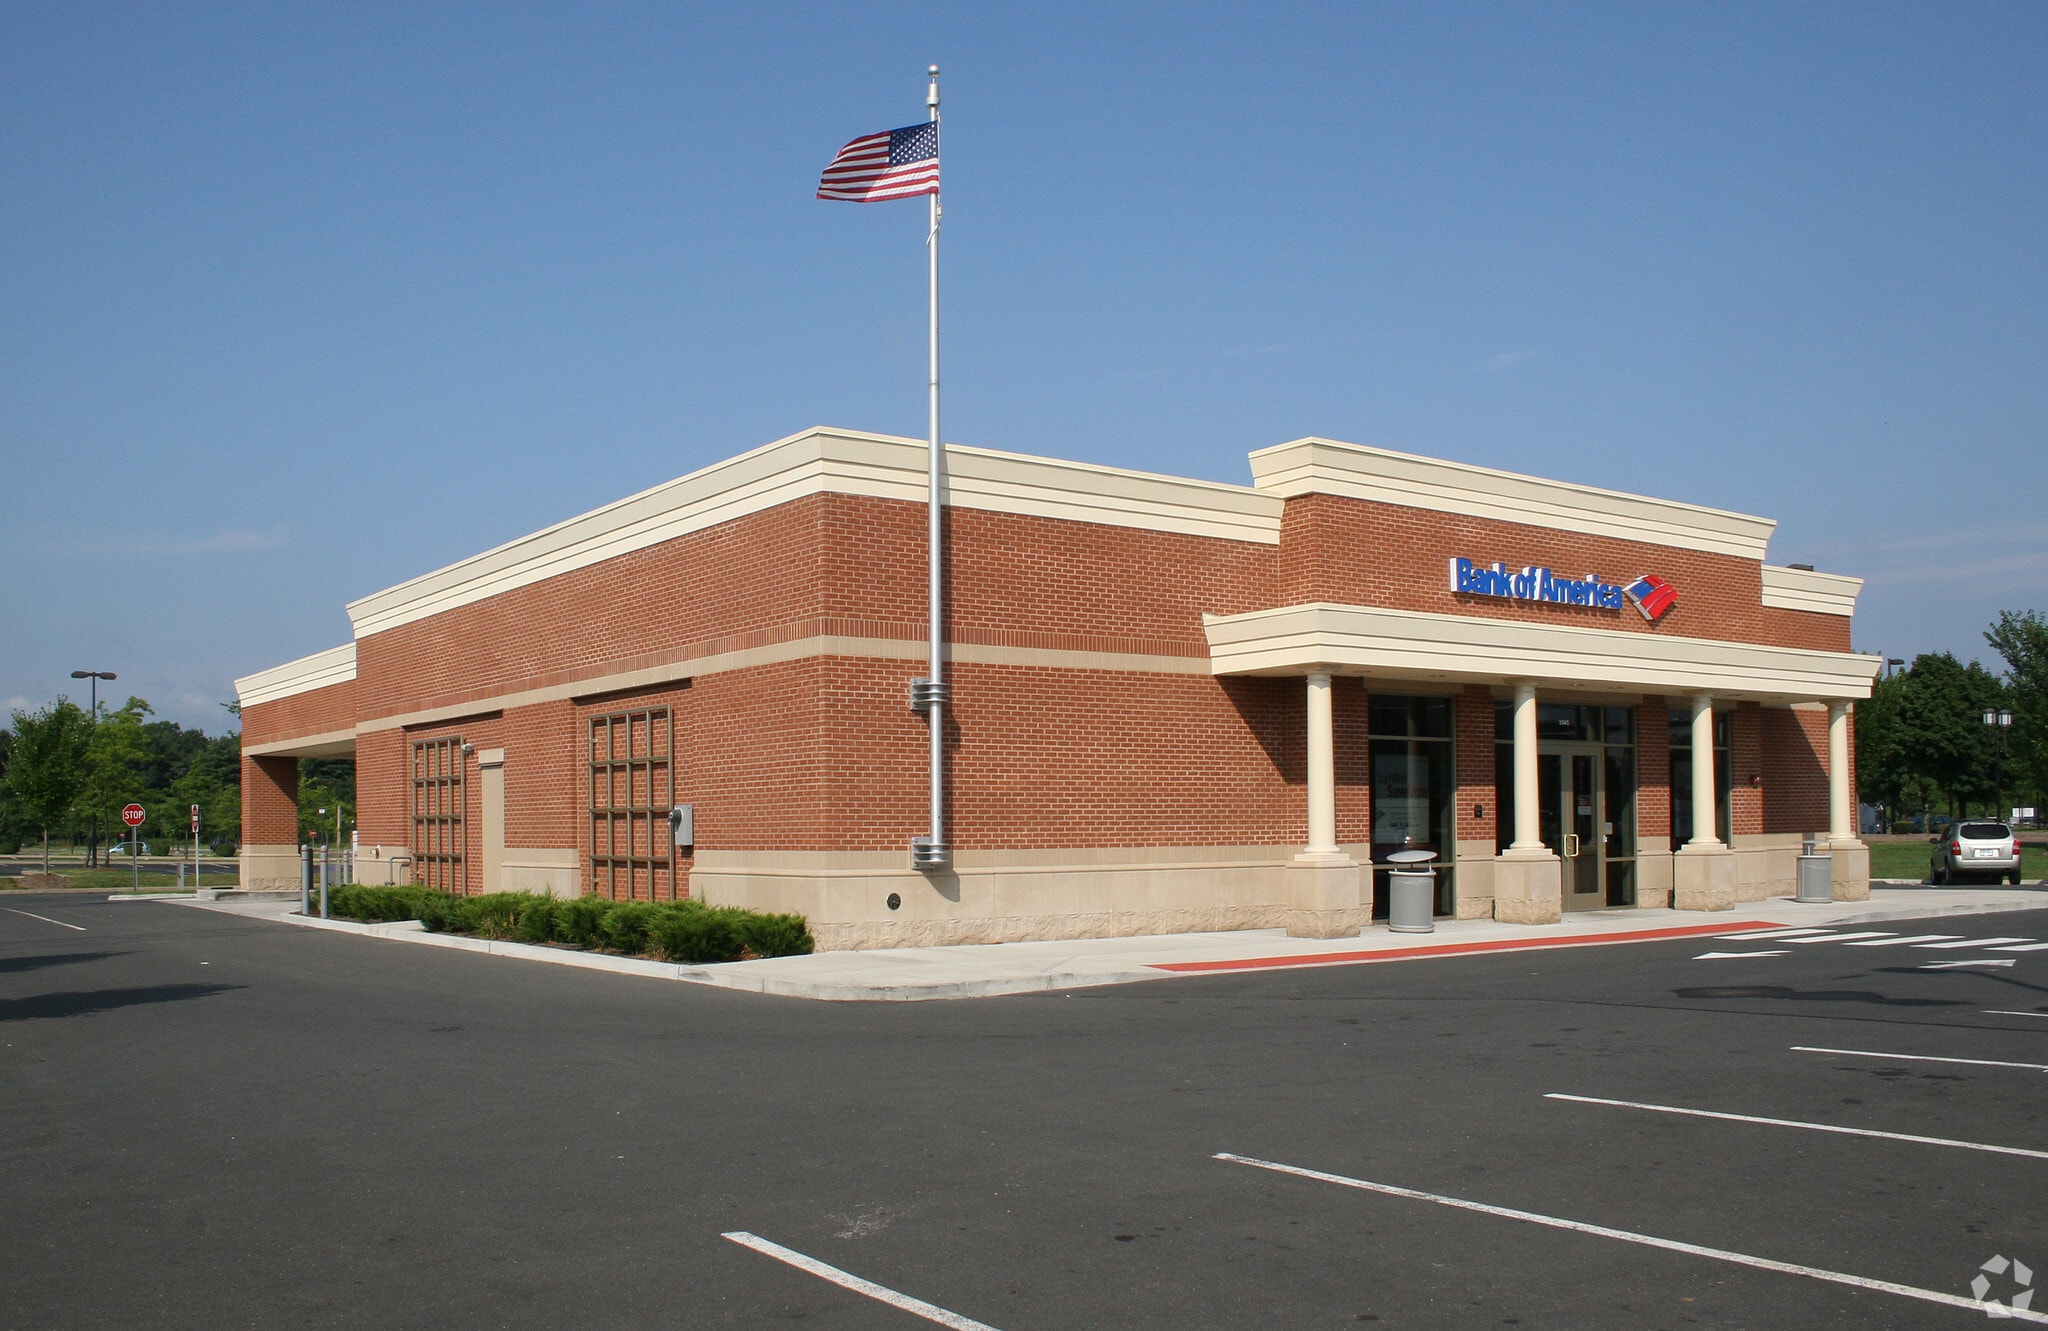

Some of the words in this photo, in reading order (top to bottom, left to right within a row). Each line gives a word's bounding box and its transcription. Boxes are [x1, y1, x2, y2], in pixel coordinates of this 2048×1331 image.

[1450, 557, 1513, 597] Bank
[1513, 565, 1538, 599] of
[1537, 568, 1622, 610] America
[124, 810, 144, 820] STOP
